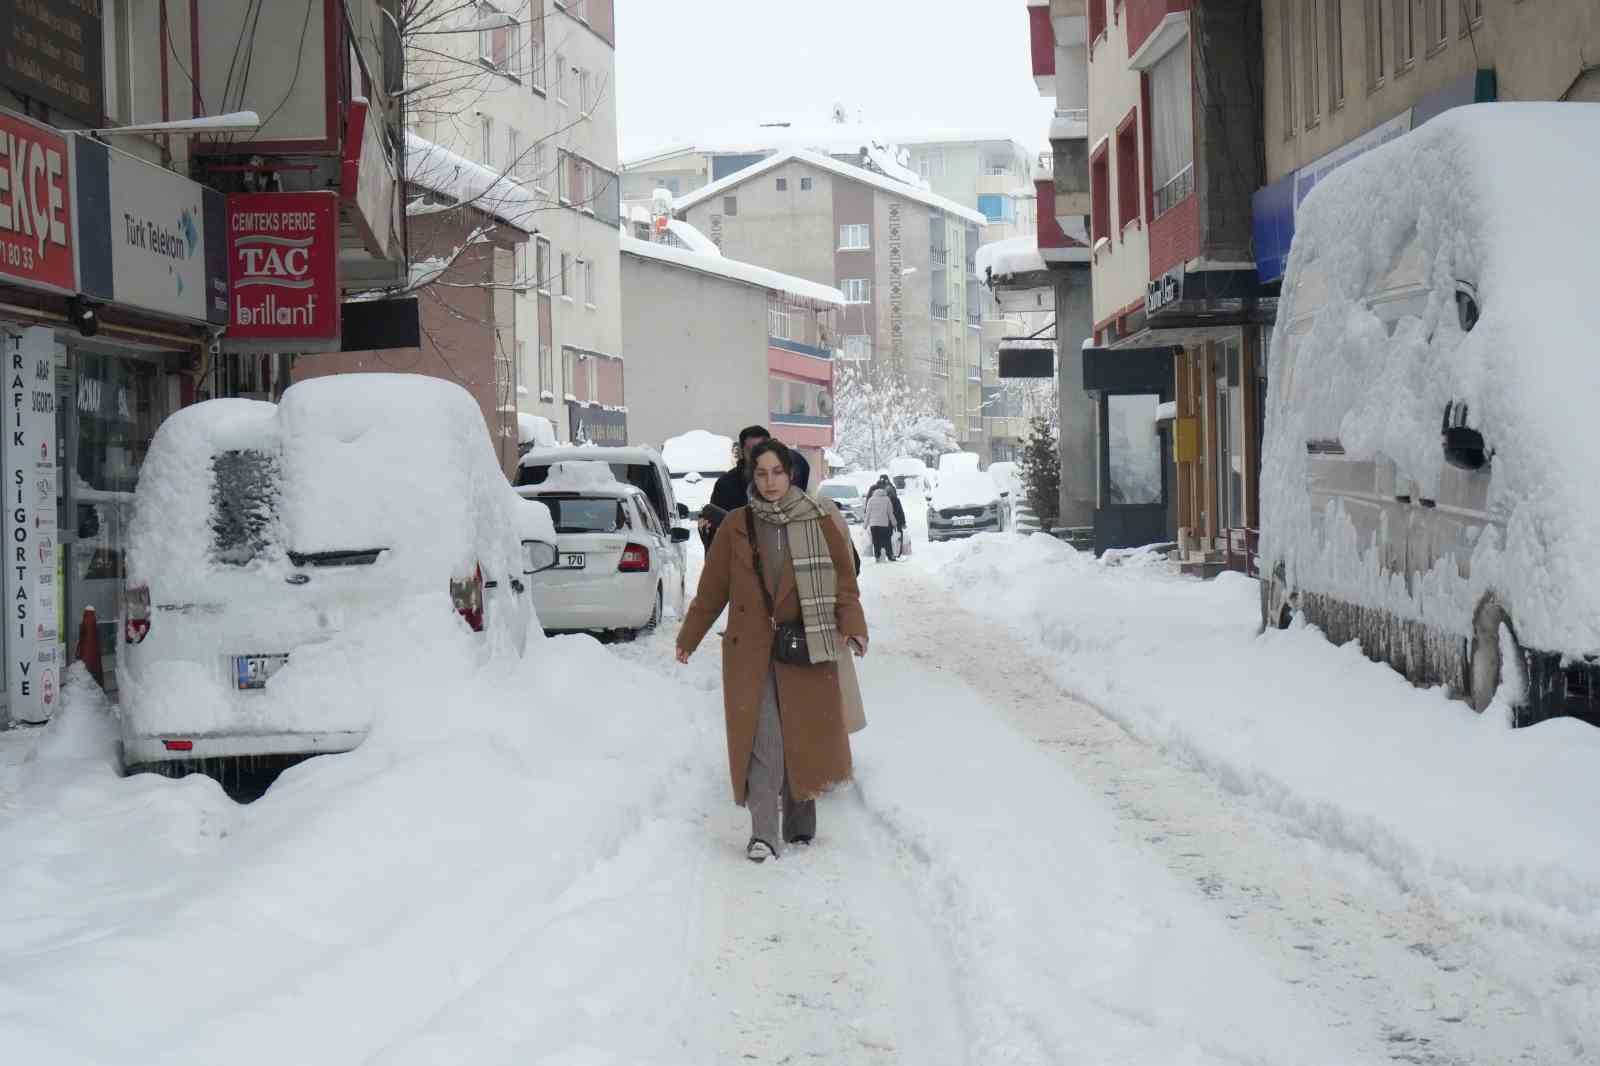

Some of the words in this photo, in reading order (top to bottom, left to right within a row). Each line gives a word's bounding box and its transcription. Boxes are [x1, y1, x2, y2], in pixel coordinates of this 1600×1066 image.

[124, 213, 146, 250] Türk
[148, 221, 185, 261] Telekom
[232, 212, 280, 231] CEMTEKS
[282, 212, 316, 230] PERDE
[236, 294, 316, 325] brillant
[8, 335, 25, 446] TRAFİK
[14, 469, 28, 638] SİGORTASI
[567, 555, 583, 566] 170
[19, 661, 31, 696] VE
